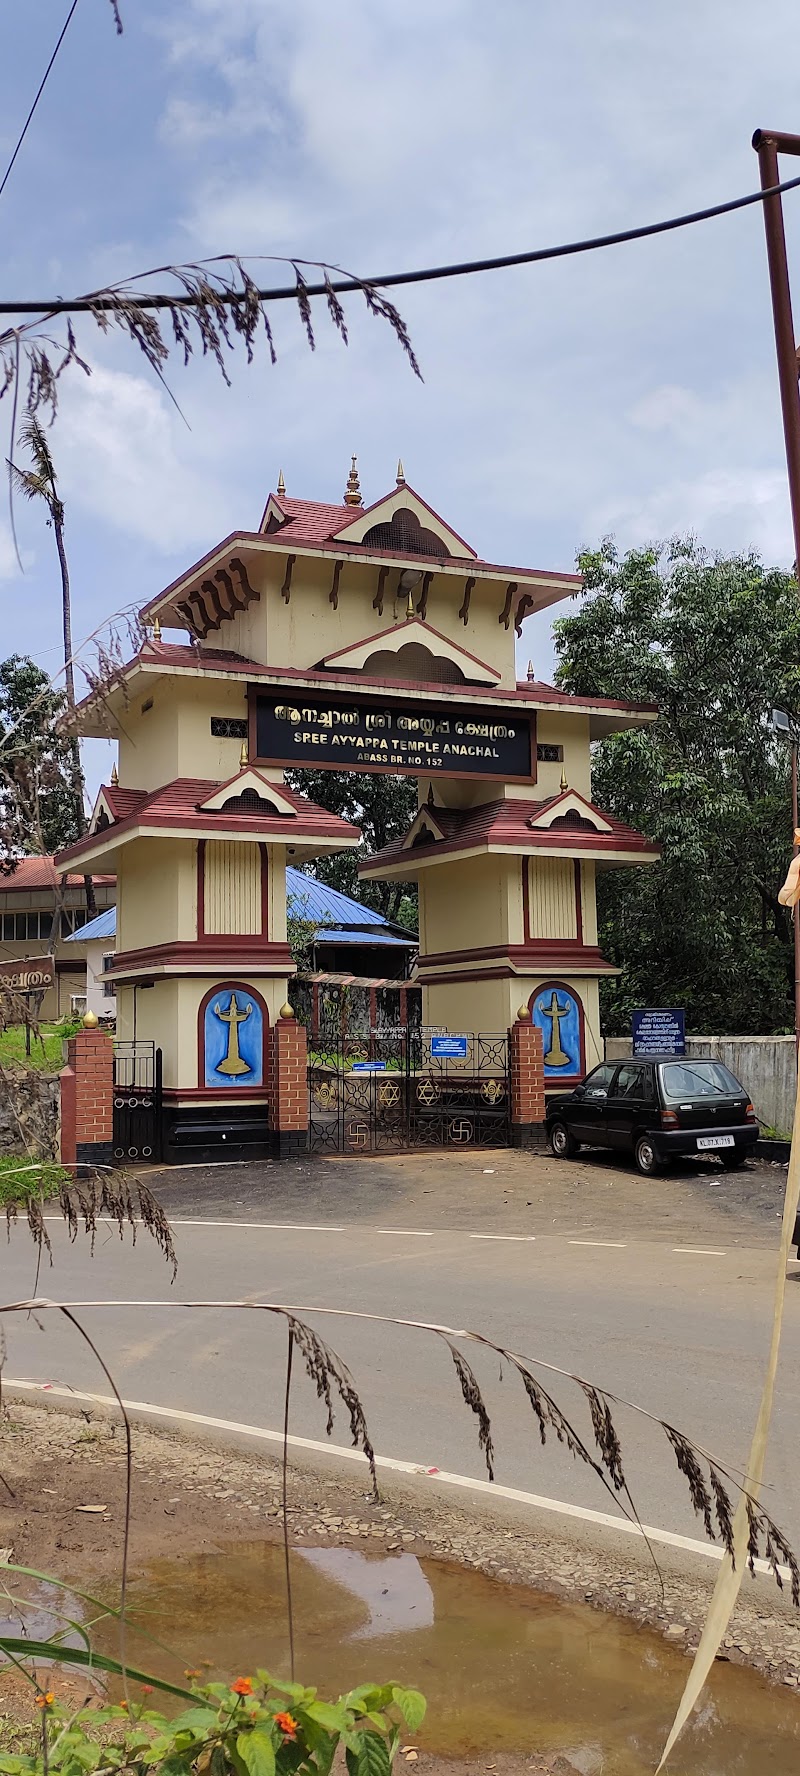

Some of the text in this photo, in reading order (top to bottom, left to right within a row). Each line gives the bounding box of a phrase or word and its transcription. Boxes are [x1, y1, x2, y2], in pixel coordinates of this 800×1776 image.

[454, 721, 516, 741] ക്ഷേത്രം
[293, 731, 500, 757] SREE AYYAPPA TEMPLE ANACHAL
[357, 752, 443, 766] ABASS BR. NO. 152
